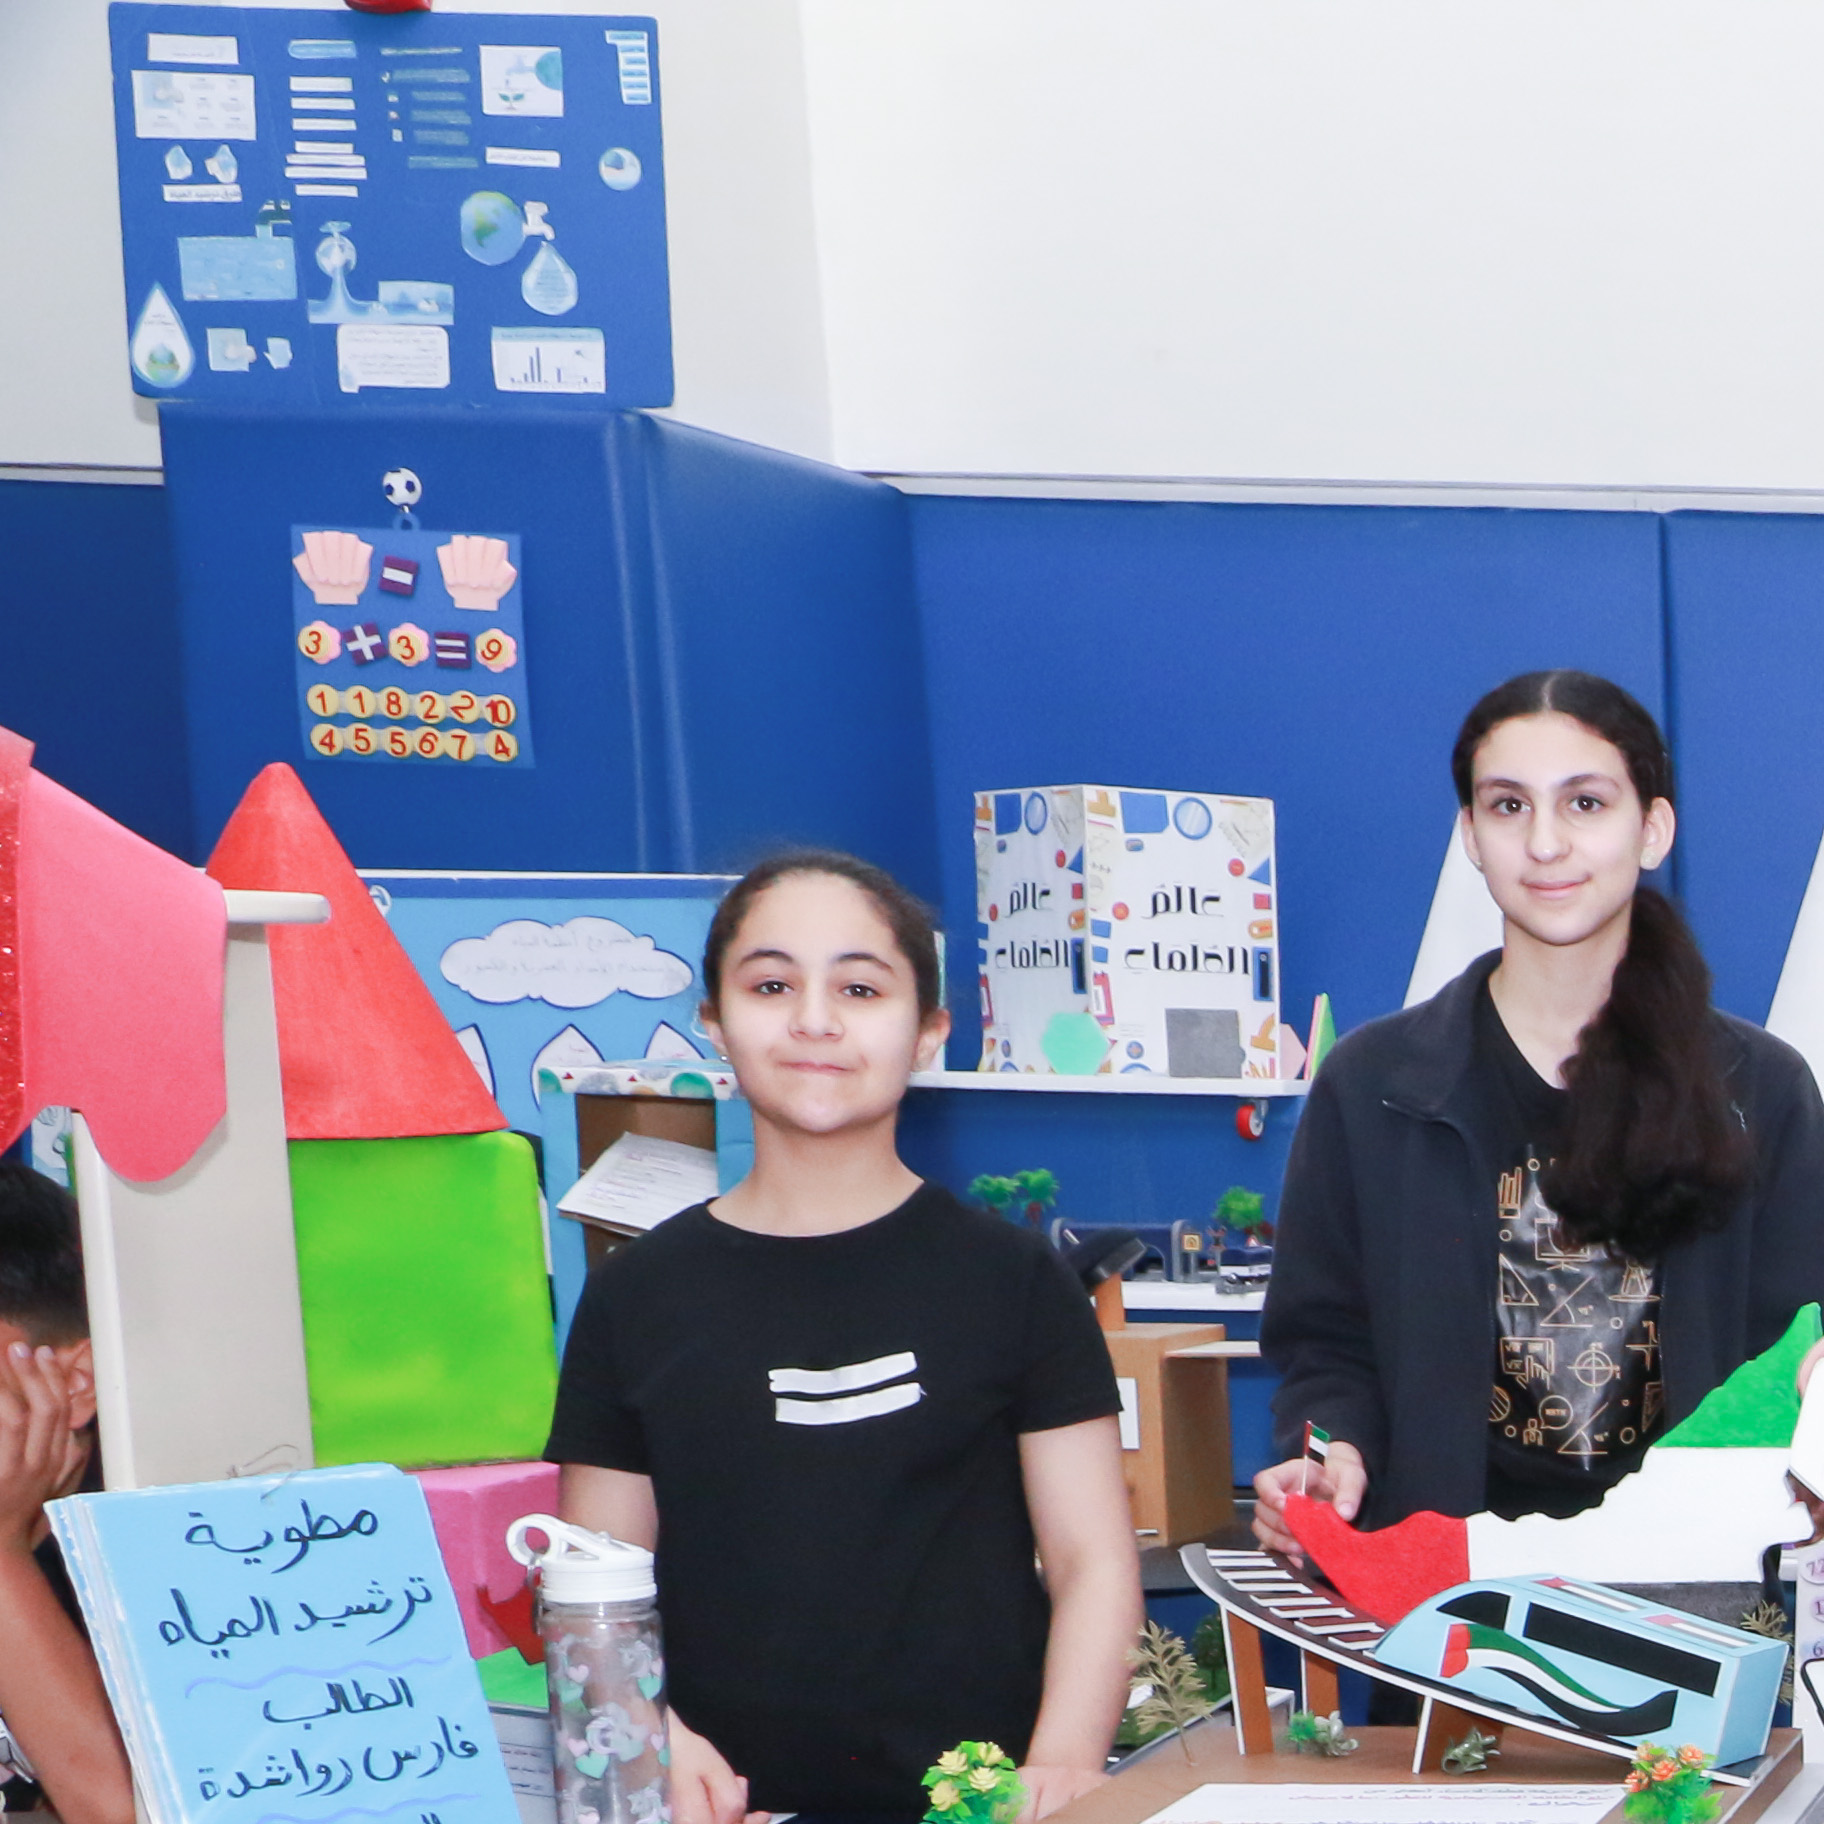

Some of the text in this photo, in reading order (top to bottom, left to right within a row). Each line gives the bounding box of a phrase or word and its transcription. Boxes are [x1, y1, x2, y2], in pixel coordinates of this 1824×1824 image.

[305, 631, 321, 654] 3
[397, 636, 415, 660] 3
[316, 691, 511, 725] 1 1 8 2 2 10
[319, 728, 510, 760] 4 5 5 6 7 4
[185, 1498, 378, 1575] مطوية
[159, 1576, 432, 1659] ترشيد المياه
[262, 1676, 414, 1730] الطالب
[363, 1716, 479, 1782] فارس
